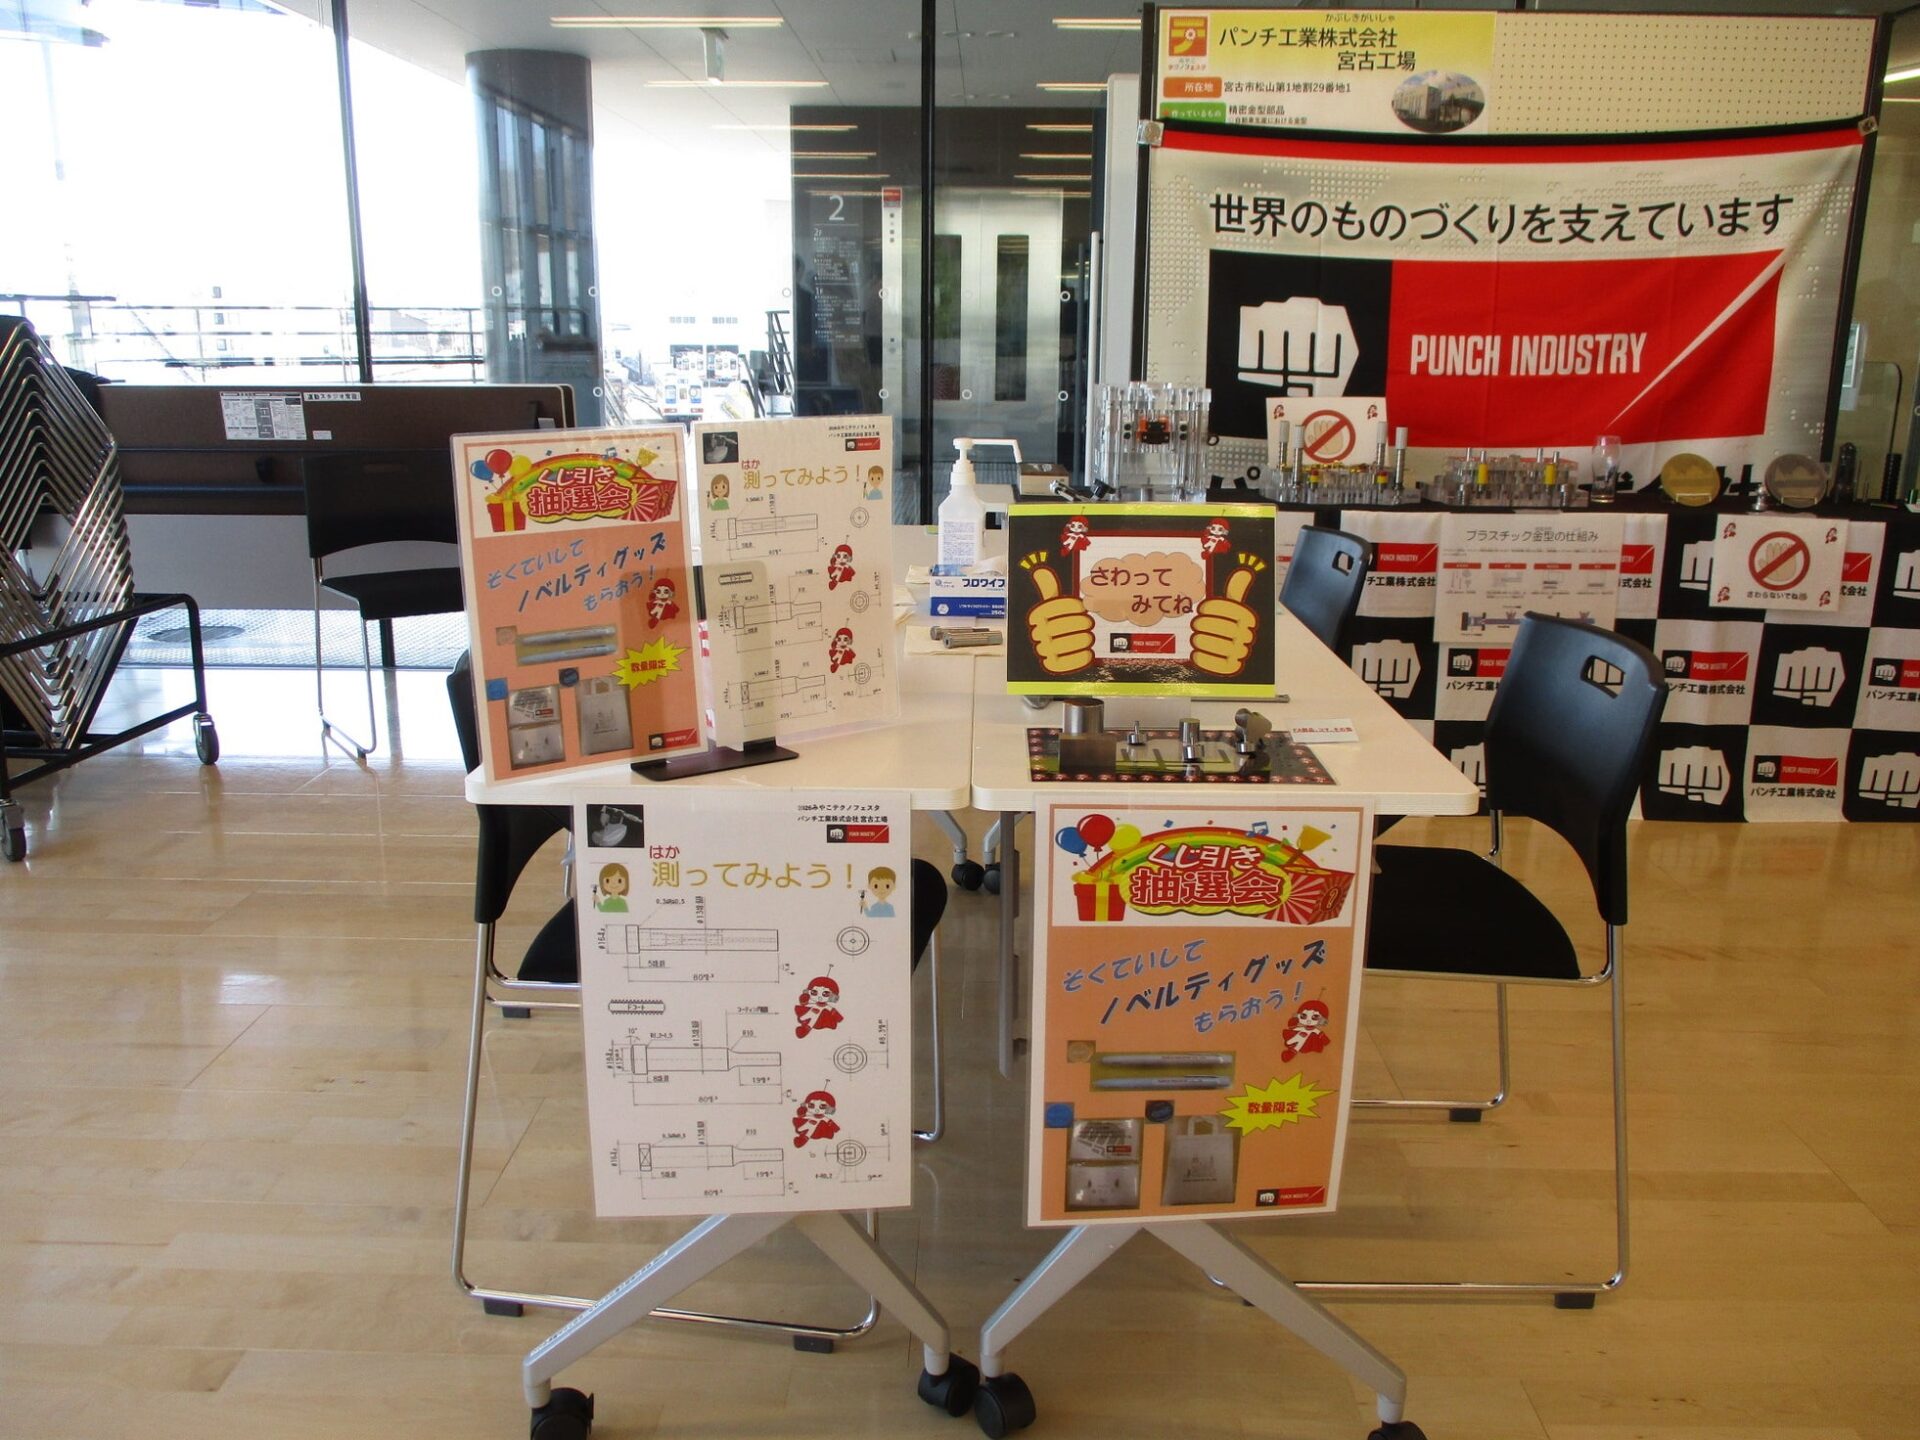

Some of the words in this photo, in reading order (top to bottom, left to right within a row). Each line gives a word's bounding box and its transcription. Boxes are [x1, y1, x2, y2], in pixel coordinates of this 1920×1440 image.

[1219, 26, 1398, 49] パンチ工業株式会社
[1337, 50, 1416, 71] 宮古工場
[1185, 82, 1214, 93] 所在地
[1224, 81, 1351, 94] 宮古市松山第1地割29番地1
[1229, 104, 1285, 115] 精密金型部品
[828, 194, 845, 221] 2
[1209, 193, 1794, 244] 世界のものづくりを支えています
[1410, 333, 1501, 377] PUNCH
[1509, 332, 1647, 376] INDUSTRY
[537, 466, 616, 485] くじ引き
[741, 459, 760, 470] はか
[744, 464, 860, 490] 測ってみよう！
[528, 484, 632, 516] 抽選会
[1466, 529, 1599, 543] プラスチック金型の仕組み
[487, 539, 585, 589] そくていして
[517, 531, 667, 612] ノベルティグッズ
[1090, 566, 1172, 586] さわって
[1131, 594, 1193, 614] みてね
[1747, 590, 1799, 600] さわらないでね
[1866, 689, 1920, 702] パンチ工業
[1750, 787, 1836, 799] パンチ工業株式会社
[649, 845, 680, 859] はか
[1147, 844, 1262, 869] くじ引き
[652, 861, 852, 889] 測ってみよう！
[1132, 869, 1283, 905] 抽選会
[1063, 939, 1206, 992] そくていして
[1100, 939, 1326, 1025] ノベルティグッズ
[1193, 981, 1304, 1033] もらおう！
[1248, 1101, 1299, 1114] 数量限定
